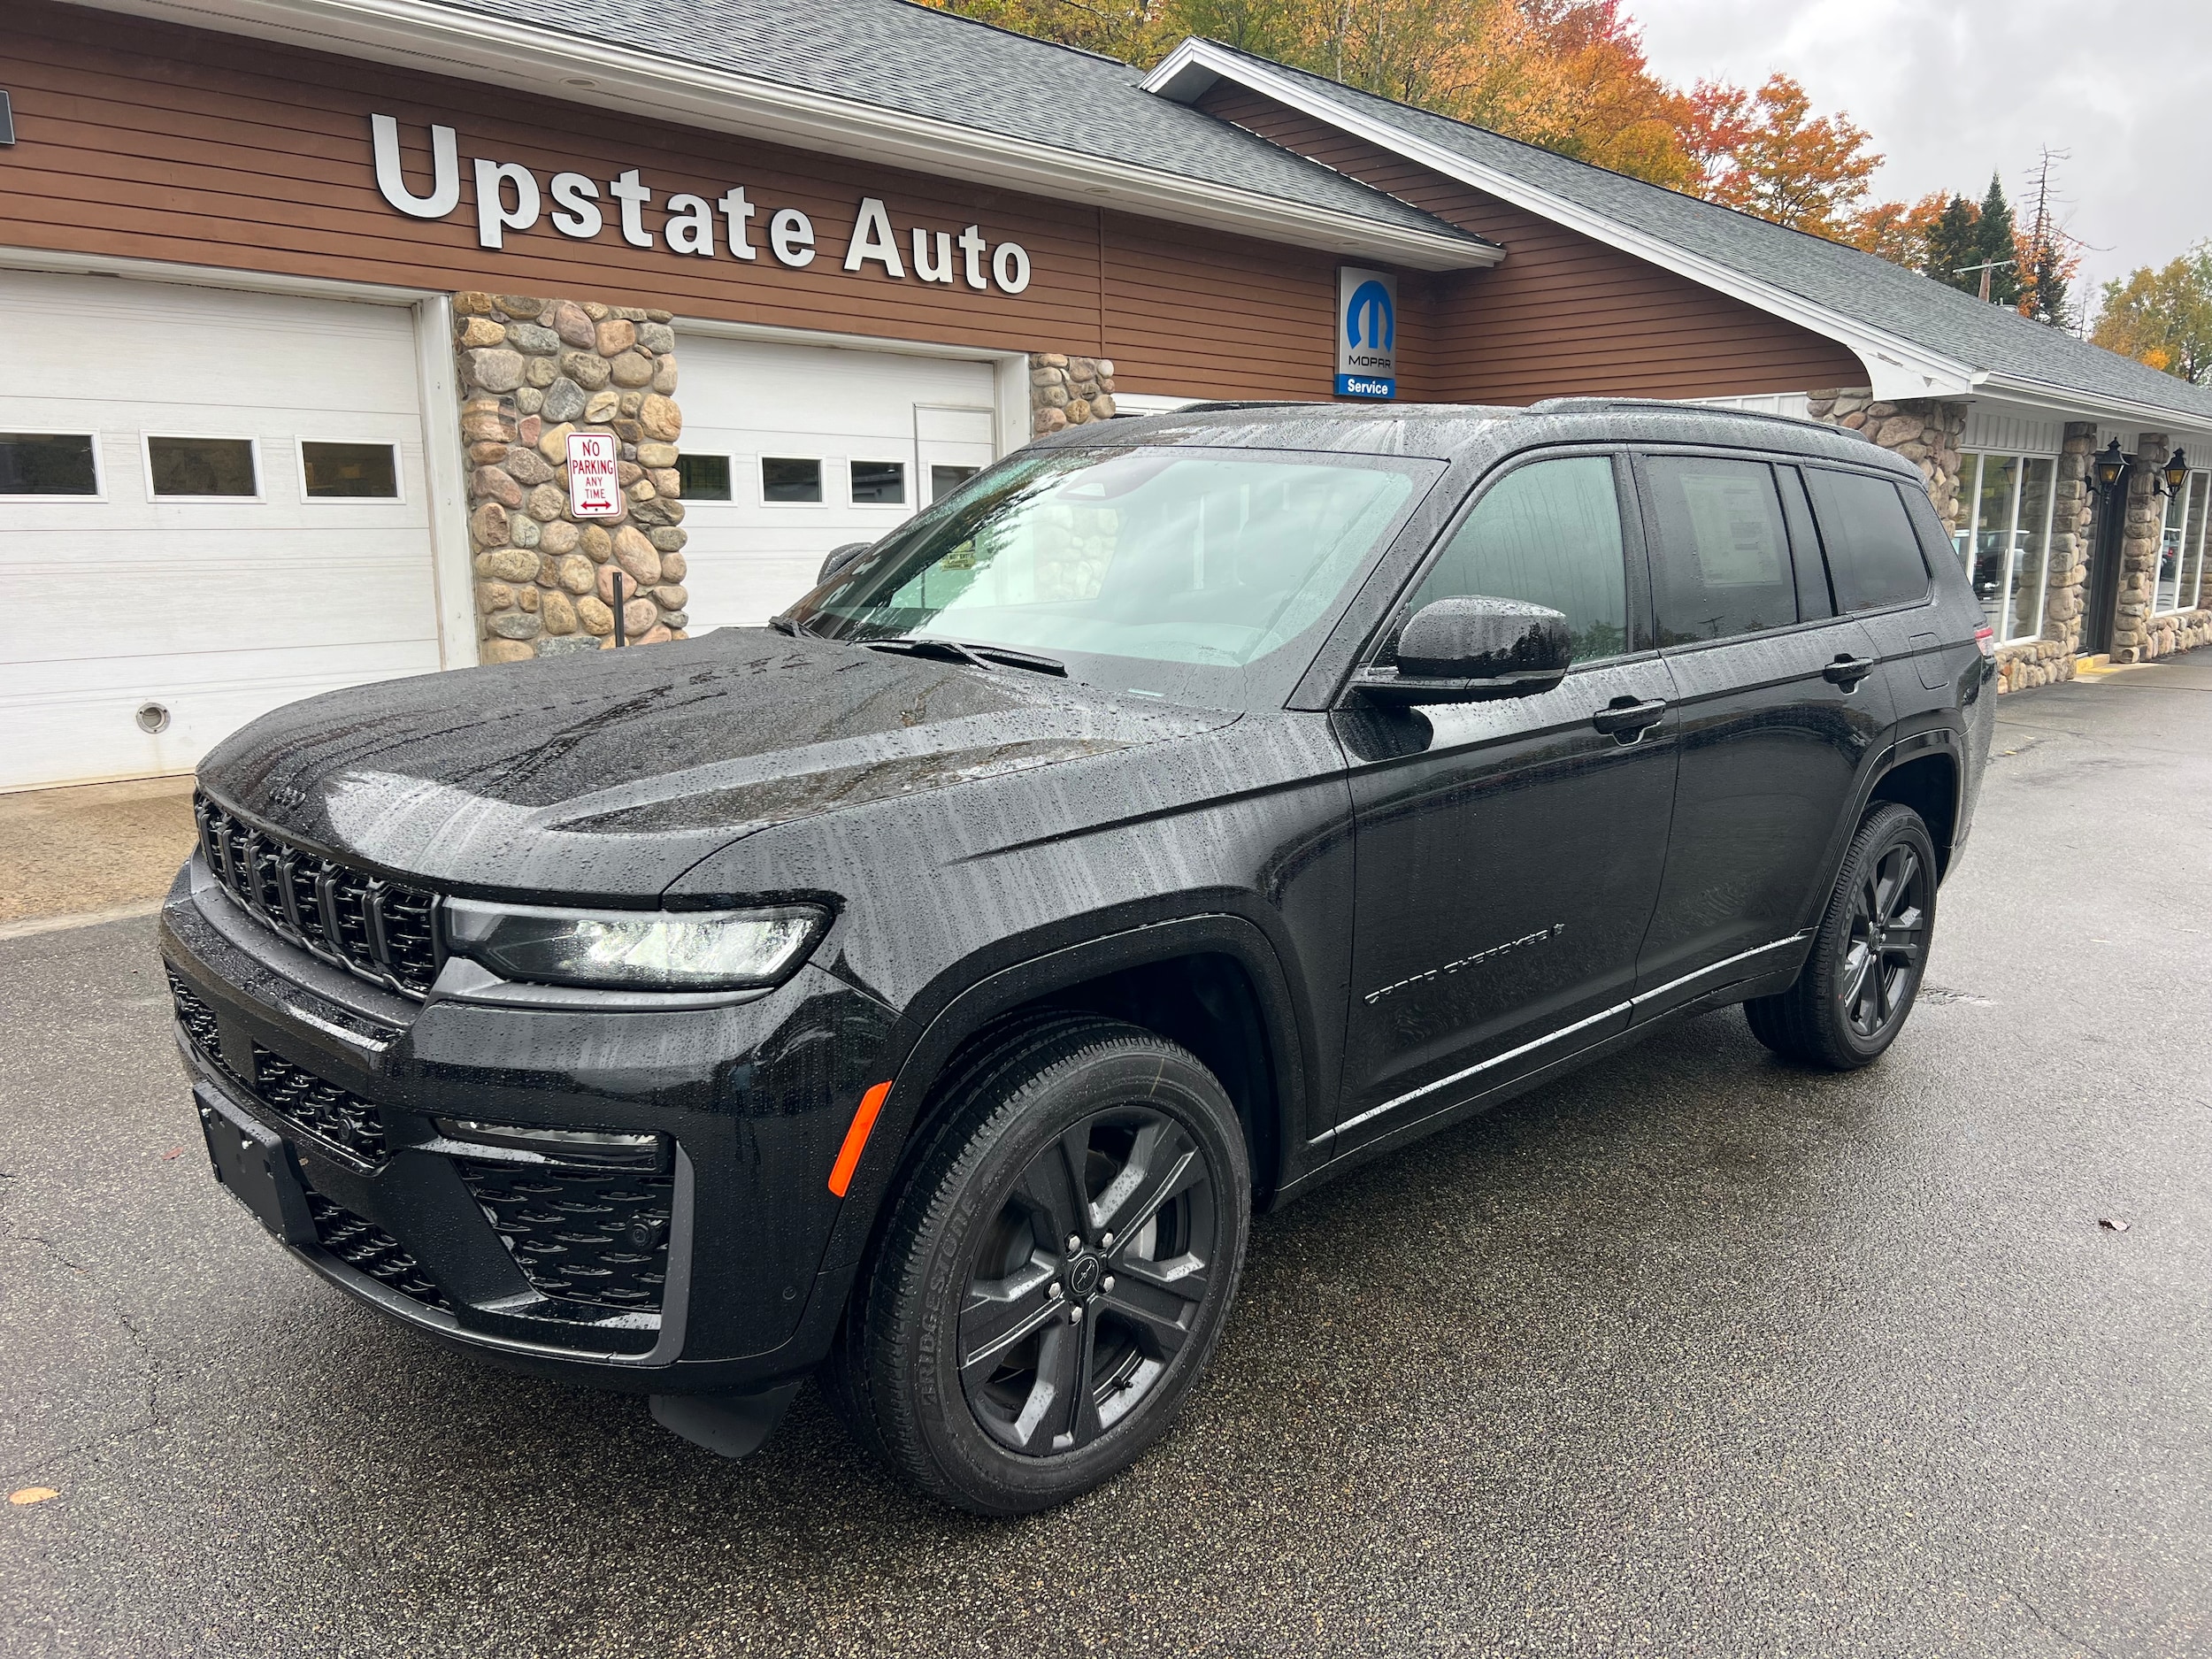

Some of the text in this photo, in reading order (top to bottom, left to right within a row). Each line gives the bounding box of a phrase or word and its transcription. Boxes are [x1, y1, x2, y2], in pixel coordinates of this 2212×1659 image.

[371, 111, 1032, 295] Upstate Auto
[1348, 355, 1391, 368] MOPAR
[1347, 378, 1388, 395] Service
[583, 442, 600, 456] NO
[572, 460, 613, 474] PARKING
[586, 477, 603, 487] ANY
[585, 488, 606, 498] TIME
